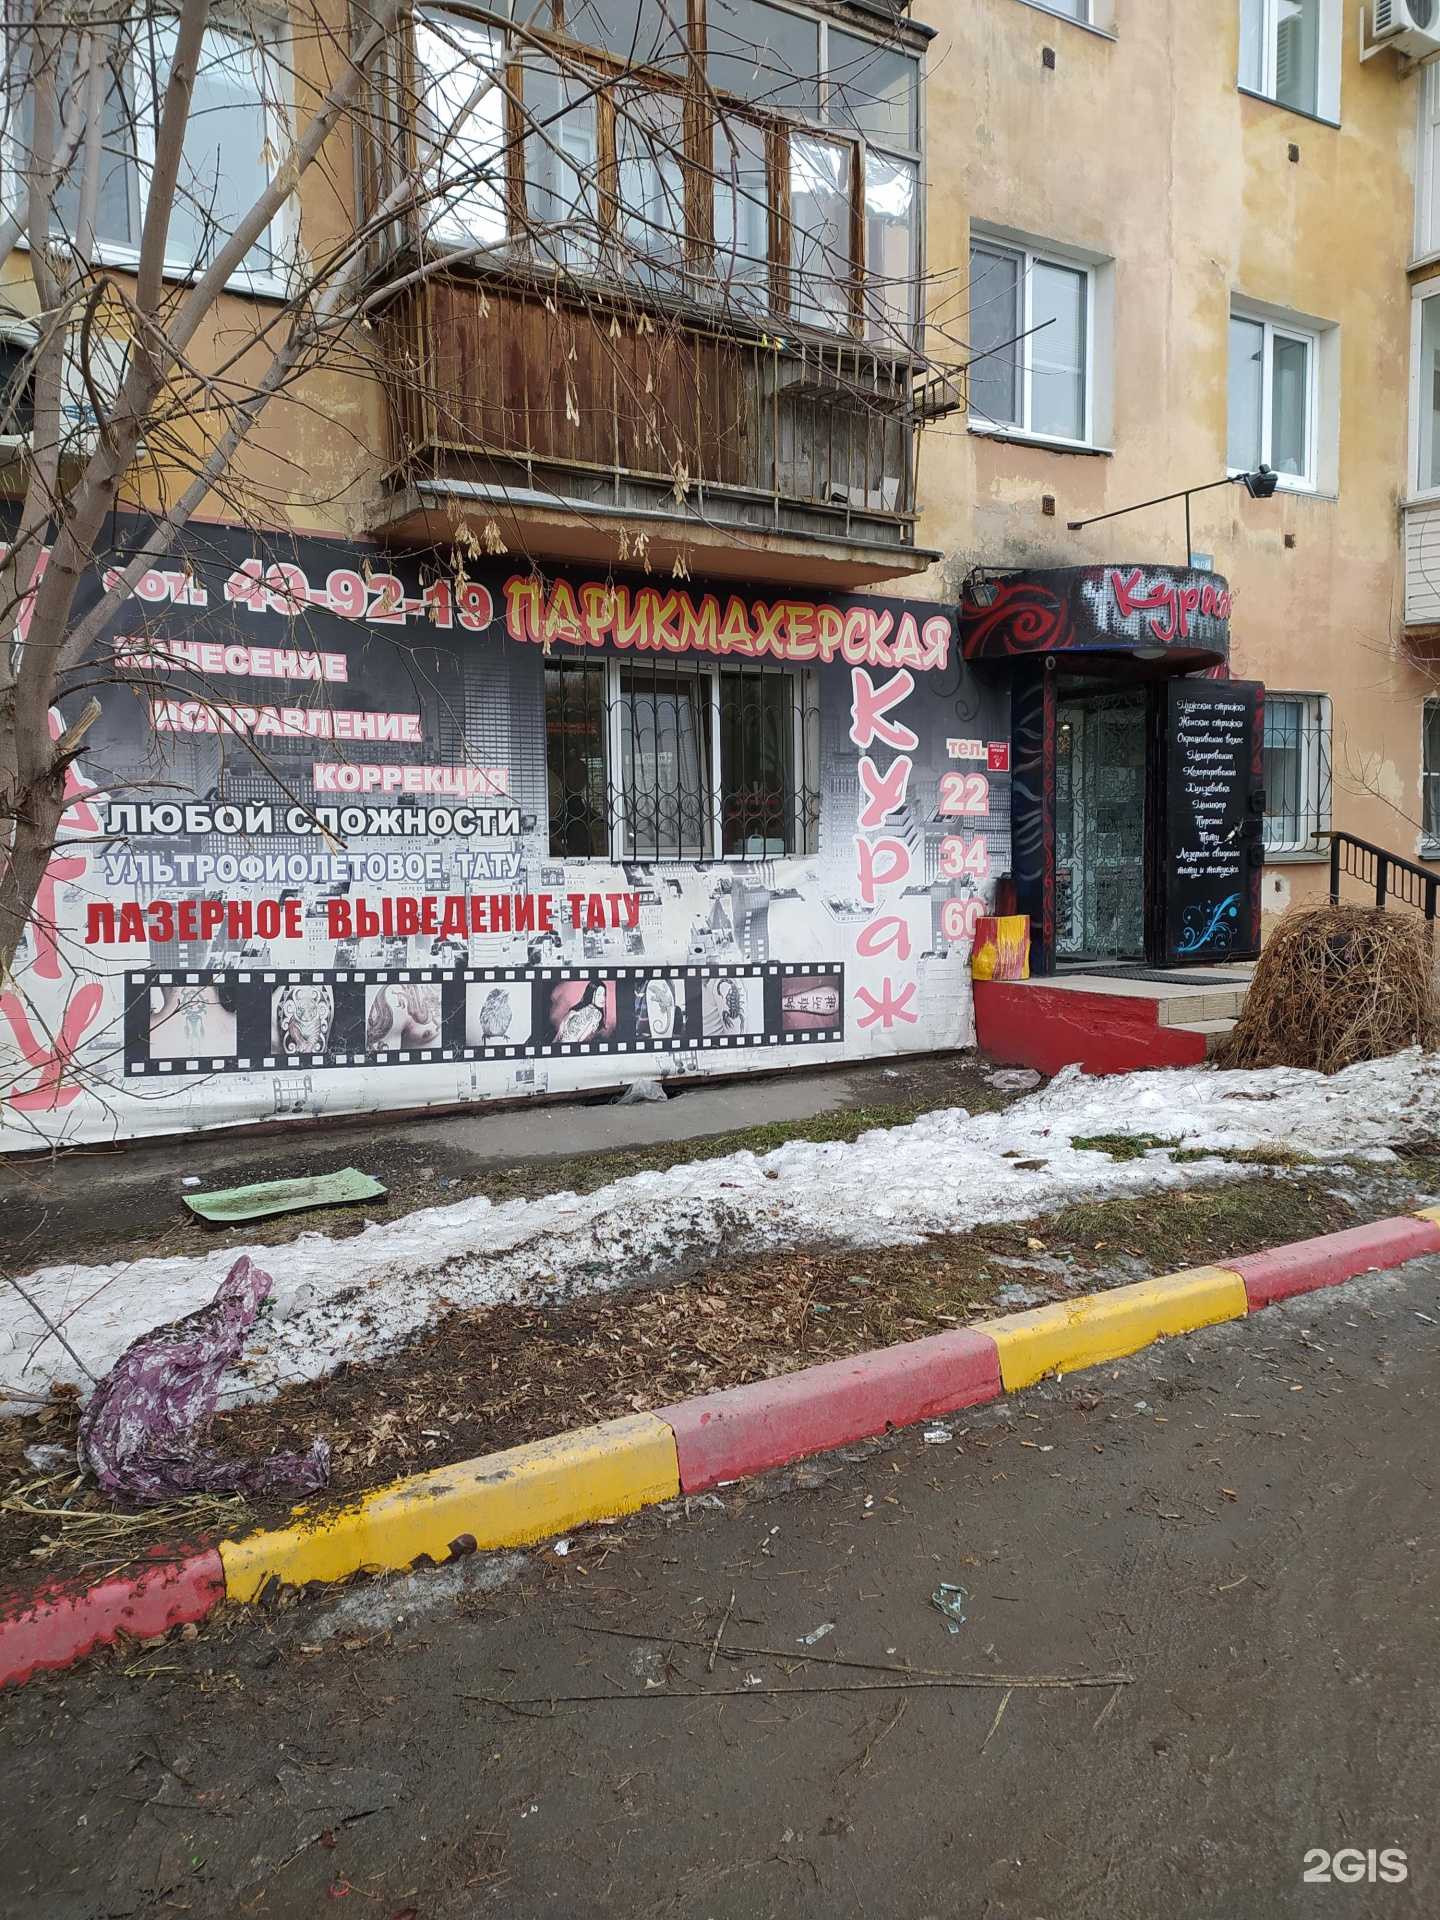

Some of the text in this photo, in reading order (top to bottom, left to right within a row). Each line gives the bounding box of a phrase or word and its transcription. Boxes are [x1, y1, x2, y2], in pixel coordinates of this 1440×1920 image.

[503, 574, 952, 671] ПАРИКМАХЕРСКАЯ
[114, 635, 349, 682] НАНЕСЕНИЕ
[150, 699, 422, 743] ИСПРАВЛЕНИЕ
[947, 739, 988, 759] тел.
[313, 763, 508, 796] КОРРЕКЦИЯ
[940, 772, 990, 817] 22
[105, 798, 523, 838] ЛЮБОЙ СЛОЖНОСТИ
[104, 848, 526, 886] УЛЬТРОФИОЛЕТОВОЕ ТАТУ
[941, 835, 989, 880] 34
[84, 891, 642, 946] ЛАЗЕРНОЕ ВЫВЕДЕНИЕ ТАТУ
[942, 897, 986, 941] 60
